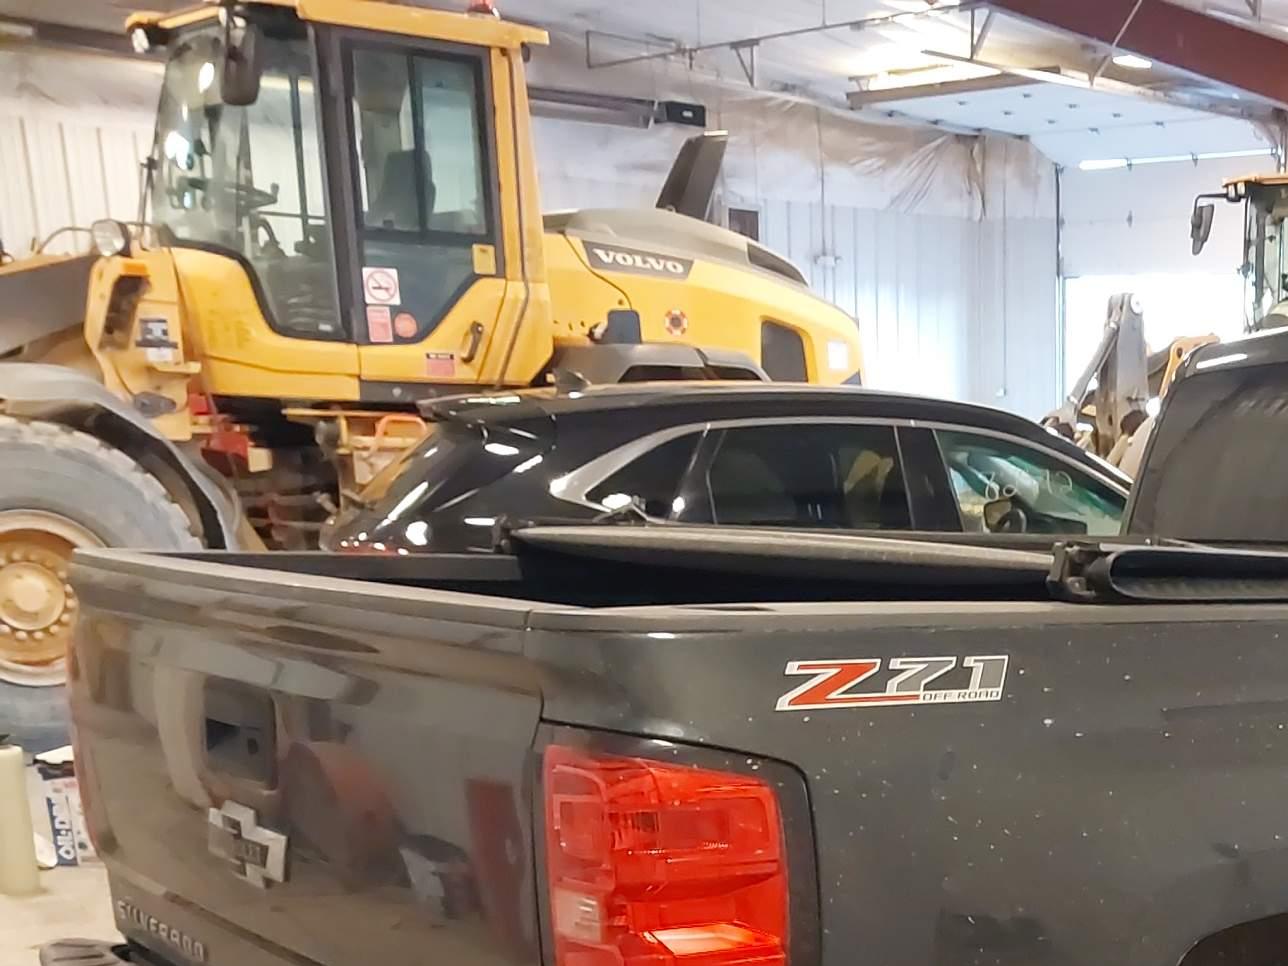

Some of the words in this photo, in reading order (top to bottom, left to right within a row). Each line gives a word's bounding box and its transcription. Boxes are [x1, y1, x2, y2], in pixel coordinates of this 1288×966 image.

[592, 248, 684, 274] VOLVO
[776, 655, 1009, 711] Z71
[922, 692, 951, 701] OFF
[957, 690, 1000, 701] ROAD
[117, 899, 205, 962] SILVERADO
